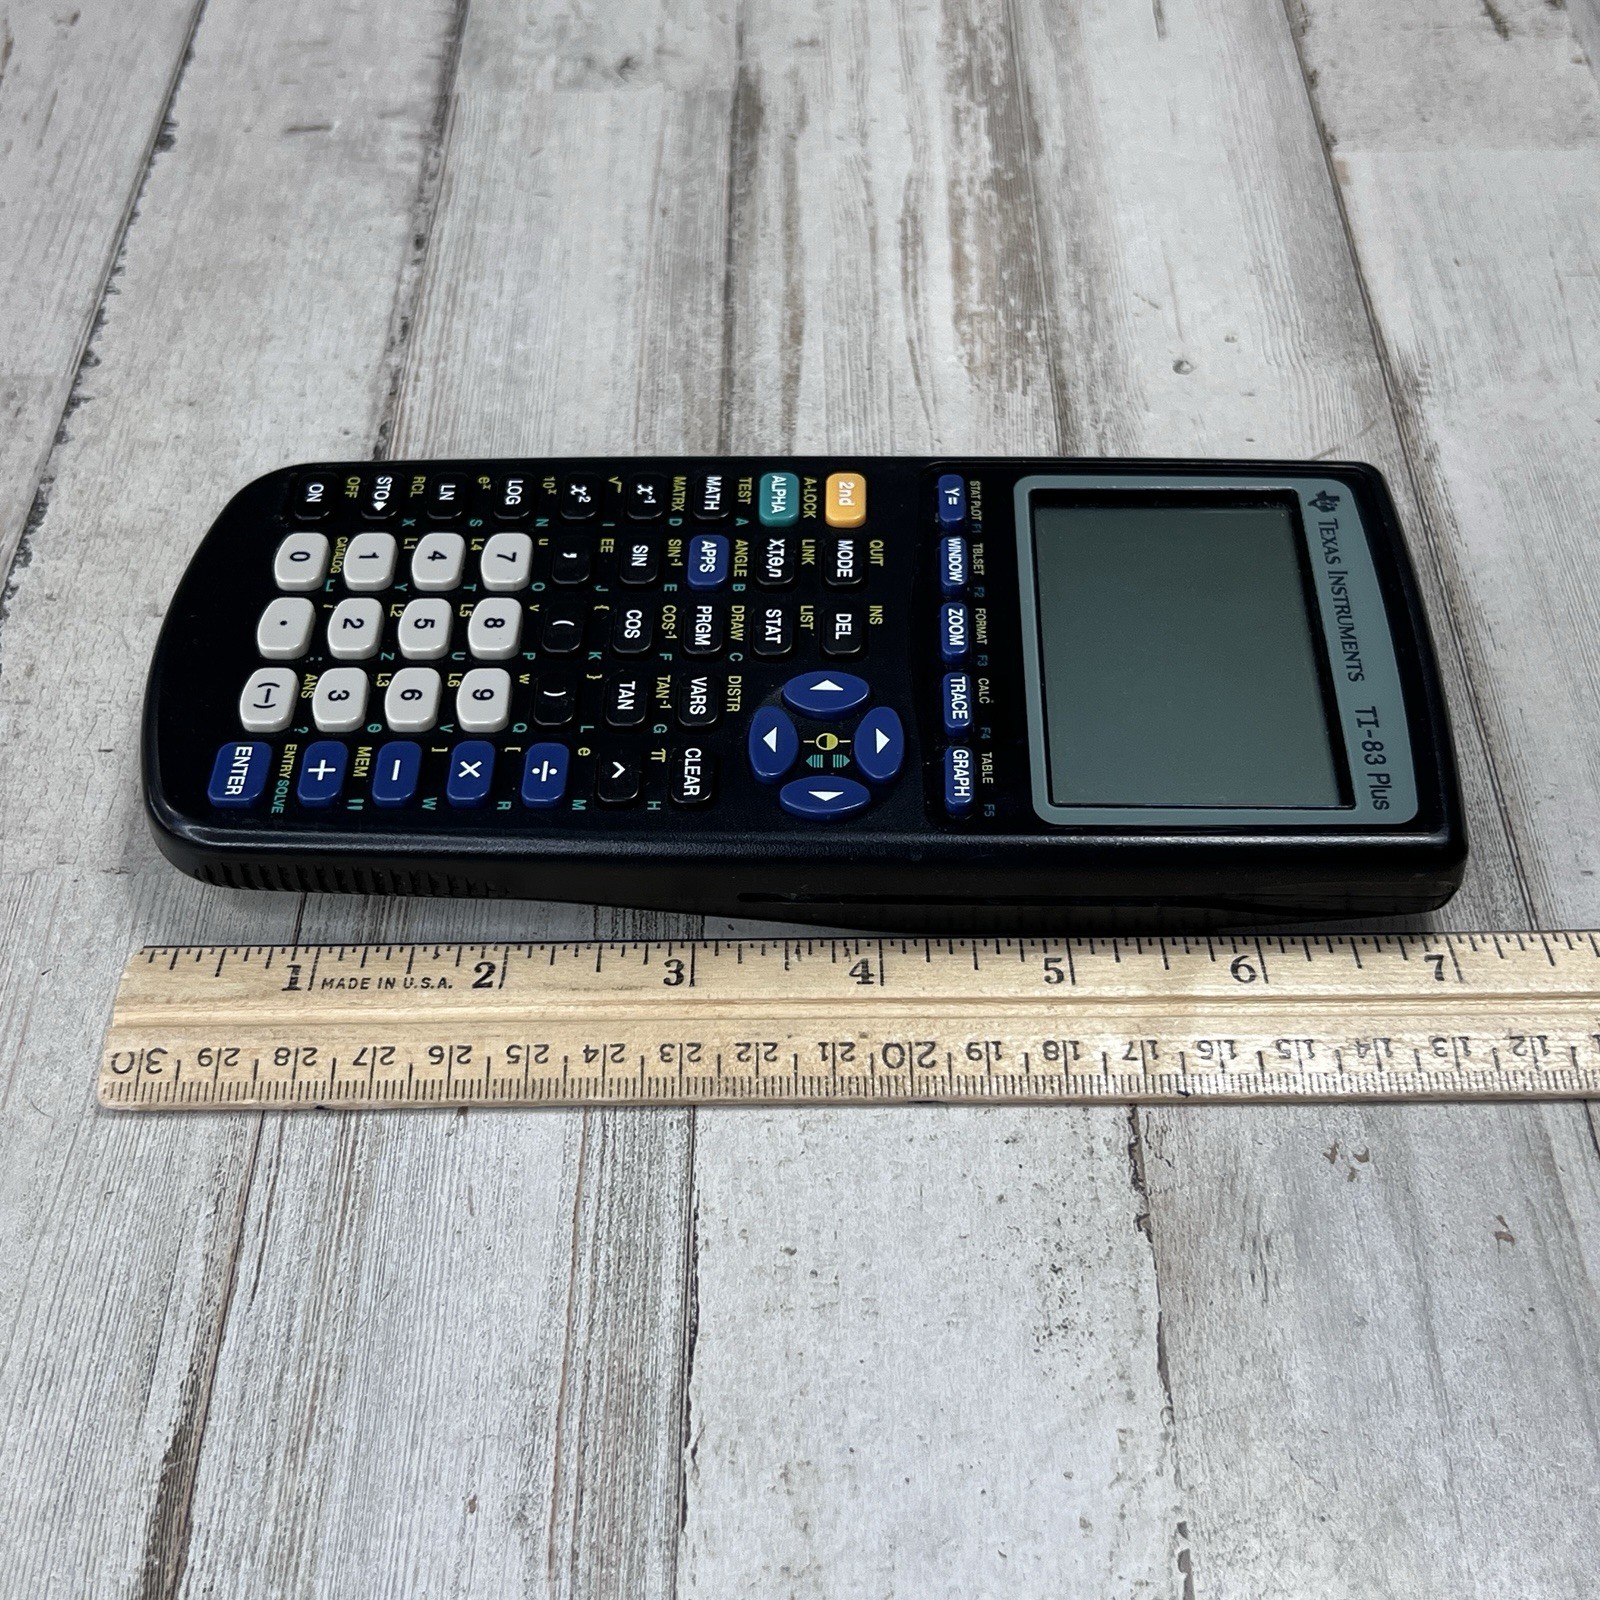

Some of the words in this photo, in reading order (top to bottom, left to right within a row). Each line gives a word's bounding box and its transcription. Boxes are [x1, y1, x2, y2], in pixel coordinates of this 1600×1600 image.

[306, 483, 325, 503] ON
[345, 476, 361, 499] OFF
[410, 476, 426, 498] RCL
[439, 484, 456, 501] LN
[505, 479, 524, 505] LOG
[671, 476, 687, 512] MATRX
[703, 475, 723, 511] MATH
[738, 477, 753, 505] TEST
[771, 475, 787, 514] ALPHA
[838, 481, 856, 507] 2nd
[944, 487, 960, 505] Y=
[969, 480, 981, 499] STAT
[803, 477, 818, 519] A-LOCK
[735, 517, 750, 526] A
[970, 501, 982, 521] PLOT
[402, 518, 416, 527] X
[469, 518, 483, 527] S
[535, 518, 550, 527] N
[668, 518, 683, 526] D
[403, 537, 418, 550] L1
[470, 538, 485, 551] L4
[600, 538, 615, 553] EE
[1318, 518, 1342, 565] TEXAS
[290, 551, 311, 562] 0
[330, 536, 349, 574] CATALOG
[358, 552, 380, 560] 1
[427, 550, 448, 561] 4
[496, 552, 517, 563] 7
[631, 545, 649, 567] SIN
[699, 540, 717, 573] APPS
[733, 539, 749, 577] ANGLE
[801, 539, 816, 566] LINK
[836, 540, 854, 578] MODE
[869, 539, 884, 567] QUIT
[948, 537, 963, 582] WINDOW
[972, 543, 985, 576] TBLSET
[394, 583, 409, 592] Y
[463, 583, 477, 592] T
[595, 584, 609, 592] J
[664, 583, 678, 592] E
[732, 583, 746, 592] B
[974, 586, 985, 598] F2
[390, 603, 405, 617] L2
[459, 603, 474, 617] L5
[800, 605, 814, 630] LIST
[869, 605, 883, 625] INS
[343, 617, 365, 629] 2
[414, 617, 436, 629] 5
[483, 617, 506, 629] 8
[624, 609, 643, 639] COS
[694, 605, 713, 646] PRGM
[730, 605, 745, 641] DRAW
[764, 609, 782, 644] STAT
[835, 613, 852, 640] DEL
[948, 608, 965, 646] ZOOM
[975, 608, 988, 645] FORMAT
[1327, 570, 1365, 683] INSTRUMENTS
[380, 652, 395, 661] Z
[451, 652, 467, 661] U
[522, 652, 536, 660] P
[588, 651, 602, 660] K
[659, 653, 673, 661] F
[729, 652, 743, 662] C
[977, 654, 988, 667] F3
[300, 673, 318, 699] ANS
[376, 673, 392, 687] L3
[447, 673, 463, 687] L6
[977, 677, 990, 704] CALC
[328, 689, 350, 702] 3
[400, 688, 423, 701] 6
[472, 688, 495, 701] 9
[617, 681, 636, 710] TAN
[689, 676, 708, 715] VARS
[726, 675, 742, 712] DISTR
[949, 676, 968, 720] TRACE
[439, 723, 455, 733] V
[512, 722, 528, 733] Q
[580, 725, 595, 733] L
[653, 723, 668, 734] G
[980, 727, 992, 739] F4
[1355, 705, 1387, 766] TI-83
[225, 746, 253, 795] ENTER
[278, 744, 298, 778] ENTRY
[352, 746, 373, 778] MEM
[981, 752, 994, 784] TABLE
[683, 748, 702, 796] CLEAR
[952, 749, 970, 797] GRAPH
[271, 779, 290, 814] SOLVE
[1366, 773, 1393, 811] Plus
[421, 797, 438, 811] W
[496, 801, 512, 810] R
[571, 799, 587, 811] M
[647, 801, 662, 811] H
[984, 803, 995, 817] F5
[281, 964, 301, 992] 1
[471, 961, 496, 989] 2
[663, 959, 685, 987] 3
[848, 958, 875, 985] 4
[1043, 957, 1065, 985] 5
[1230, 955, 1257, 984] 6
[1424, 954, 1445, 982] 7
[321, 977, 370, 990] MADE
[377, 977, 396, 990] IN
[403, 976, 454, 990] U.S.A.
[352, 1046, 396, 1066] 27
[428, 1045, 473, 1065] 26
[506, 1043, 549, 1065] 25
[583, 1043, 626, 1064] 24
[659, 1042, 702, 1063] 23
[736, 1042, 778, 1063] 22
[817, 1041, 857, 1062] 21
[881, 1040, 937, 1069] 20
[965, 1040, 1003, 1061] 19
[1042, 1039, 1080, 1061] 18
[1121, 1039, 1159, 1061] 17
[1197, 1039, 1237, 1060] 16
[1275, 1038, 1316, 1060] 15
[1432, 1035, 1472, 1058] 13
[1509, 1034, 1550, 1057] 12
[110, 1047, 168, 1075] 30
[197, 1047, 241, 1067] 29
[273, 1047, 318, 1067] 28
